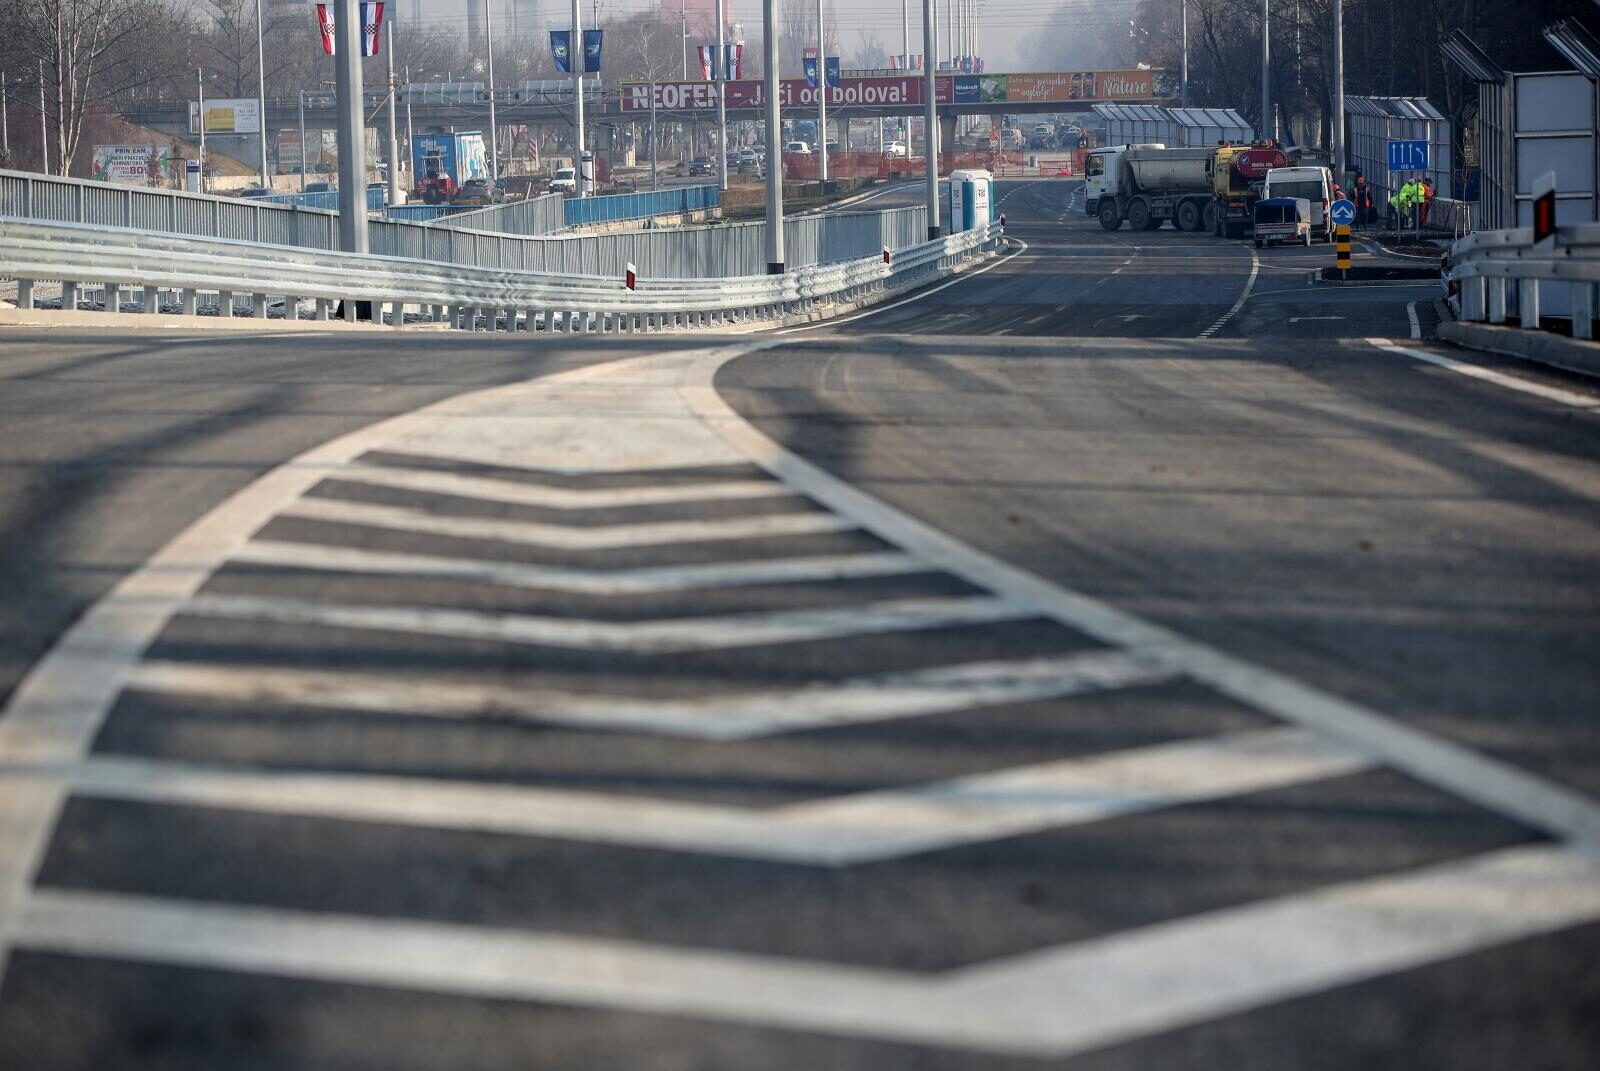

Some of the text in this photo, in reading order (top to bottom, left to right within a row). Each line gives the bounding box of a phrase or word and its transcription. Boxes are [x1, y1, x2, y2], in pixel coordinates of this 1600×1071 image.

[632, 84, 718, 109] NEOFEN
[832, 81, 907, 104] bolova!
[1103, 76, 1148, 97] Nature
